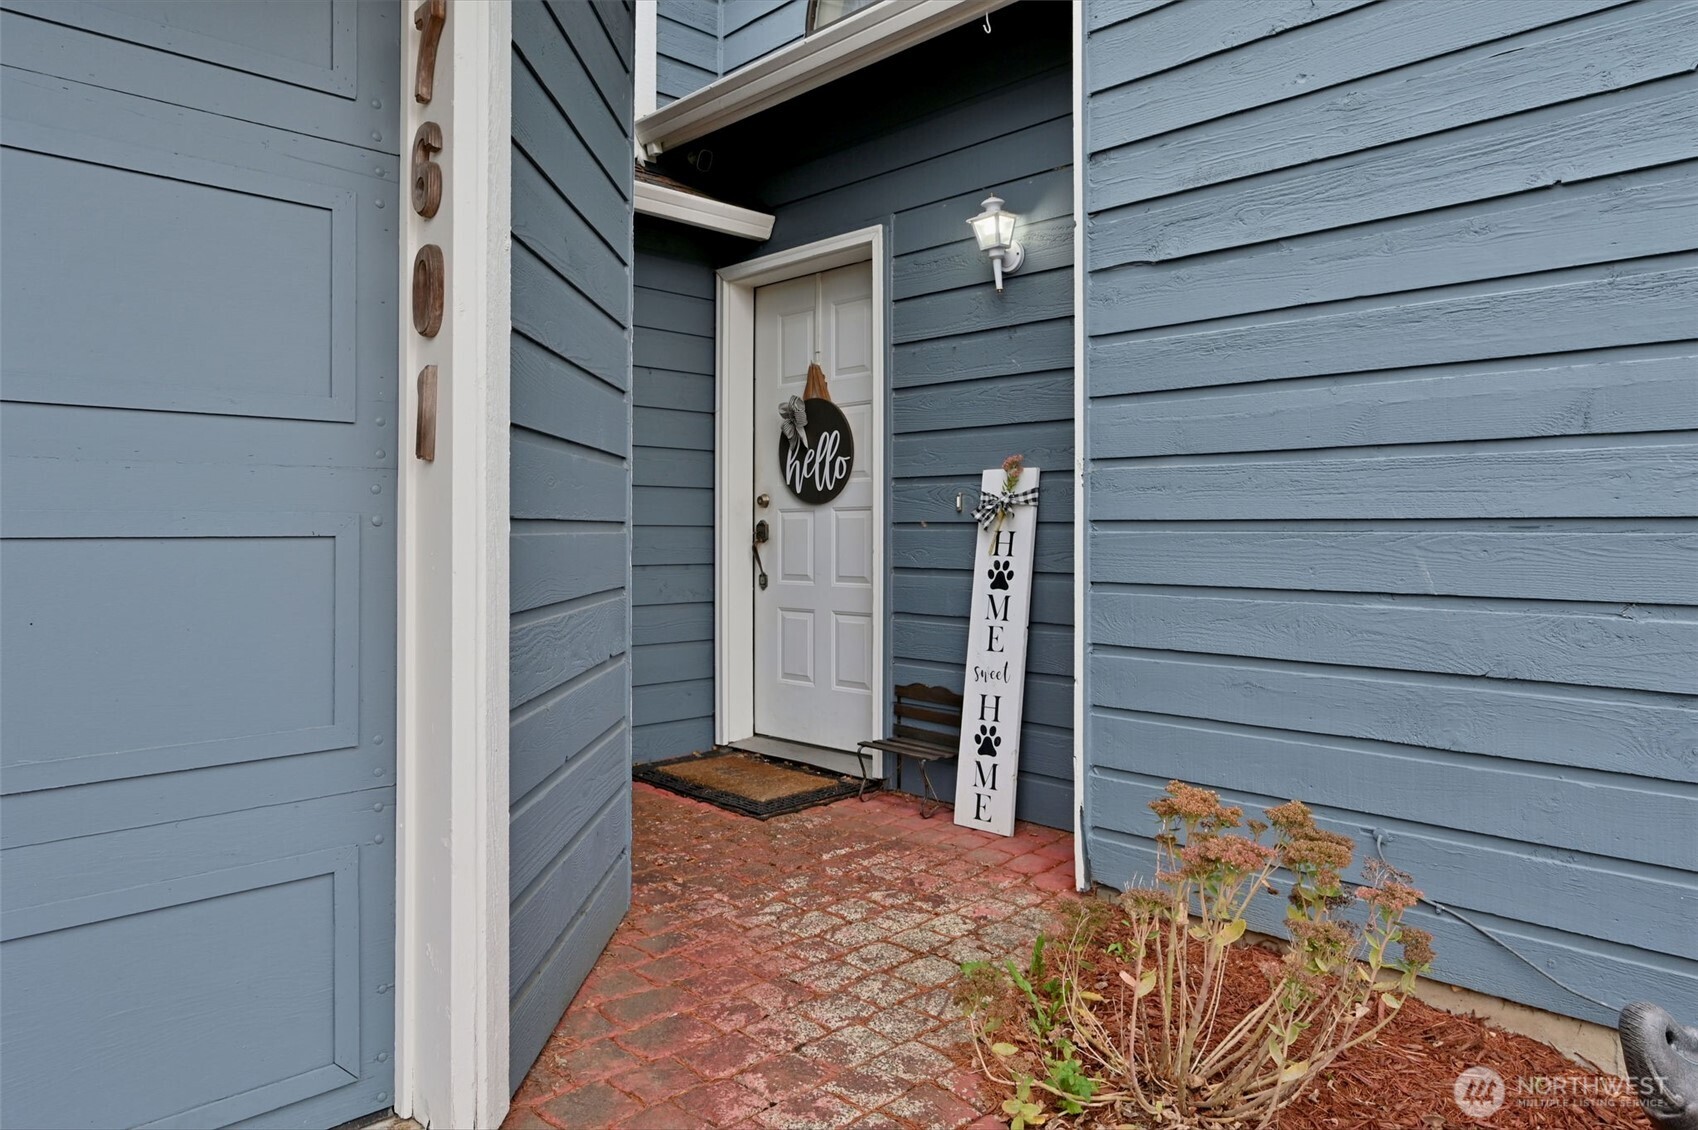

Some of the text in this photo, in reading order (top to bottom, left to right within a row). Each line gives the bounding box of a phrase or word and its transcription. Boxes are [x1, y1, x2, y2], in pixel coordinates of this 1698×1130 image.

[786, 430, 850, 494] hello
[985, 530, 1016, 653] HME
[973, 661, 1011, 683] sweet
[973, 693, 1002, 823] HME
